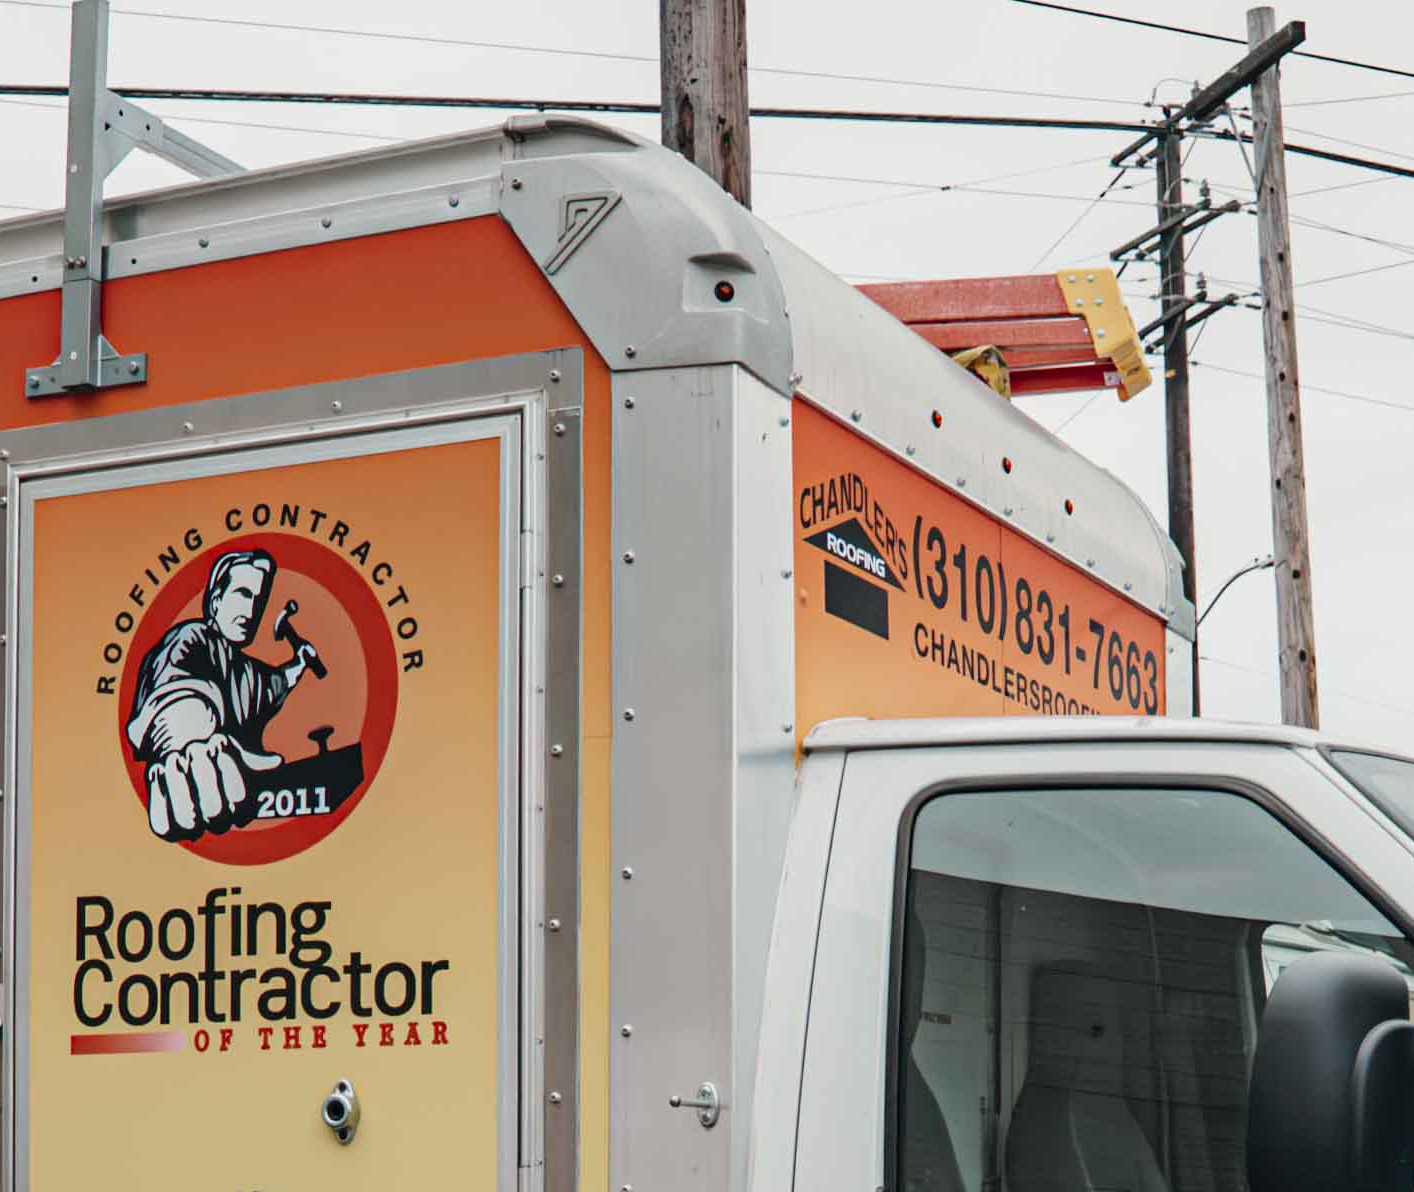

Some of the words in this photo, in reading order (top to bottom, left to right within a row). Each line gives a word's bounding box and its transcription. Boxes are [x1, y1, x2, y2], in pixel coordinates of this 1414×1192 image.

[800, 472, 908, 580] CHANDLER'S
[826, 531, 886, 578] ROOFING
[97, 528, 203, 695] ROOFING
[225, 503, 424, 672] CONTRACTOR
[257, 786, 331, 818] 2011
[75, 886, 332, 970] Roofing
[73, 952, 449, 1027] Contractor
[194, 1029, 233, 1053] OF
[258, 1025, 327, 1051] THE
[352, 1020, 449, 1047] YEAR
